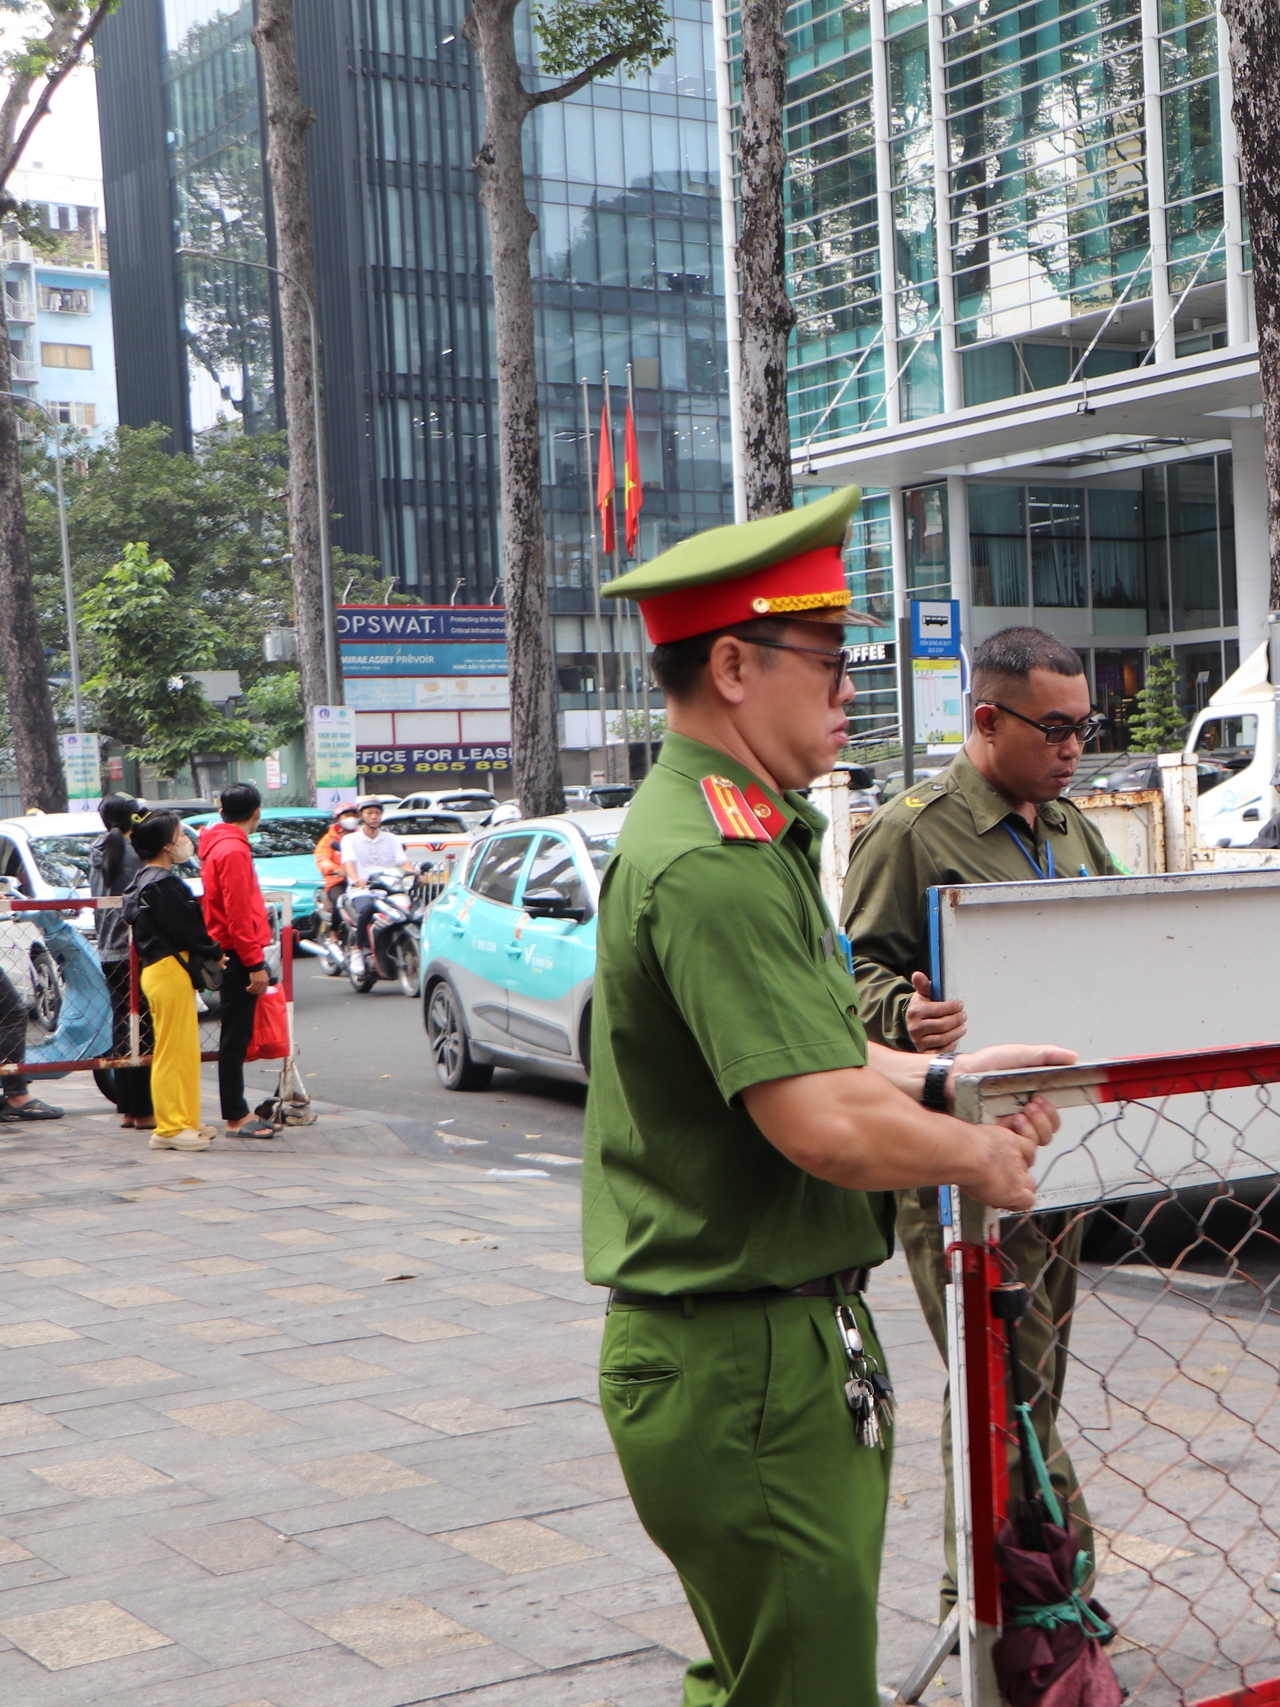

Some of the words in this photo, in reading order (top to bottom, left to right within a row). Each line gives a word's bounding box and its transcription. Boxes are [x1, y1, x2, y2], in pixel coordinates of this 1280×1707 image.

[451, 615, 479, 624] Protecting
[369, 655, 395, 664] ASSET
[413, 748, 453, 762] FOR
[415, 761, 467, 773] 865
[475, 760, 512, 771] 85
